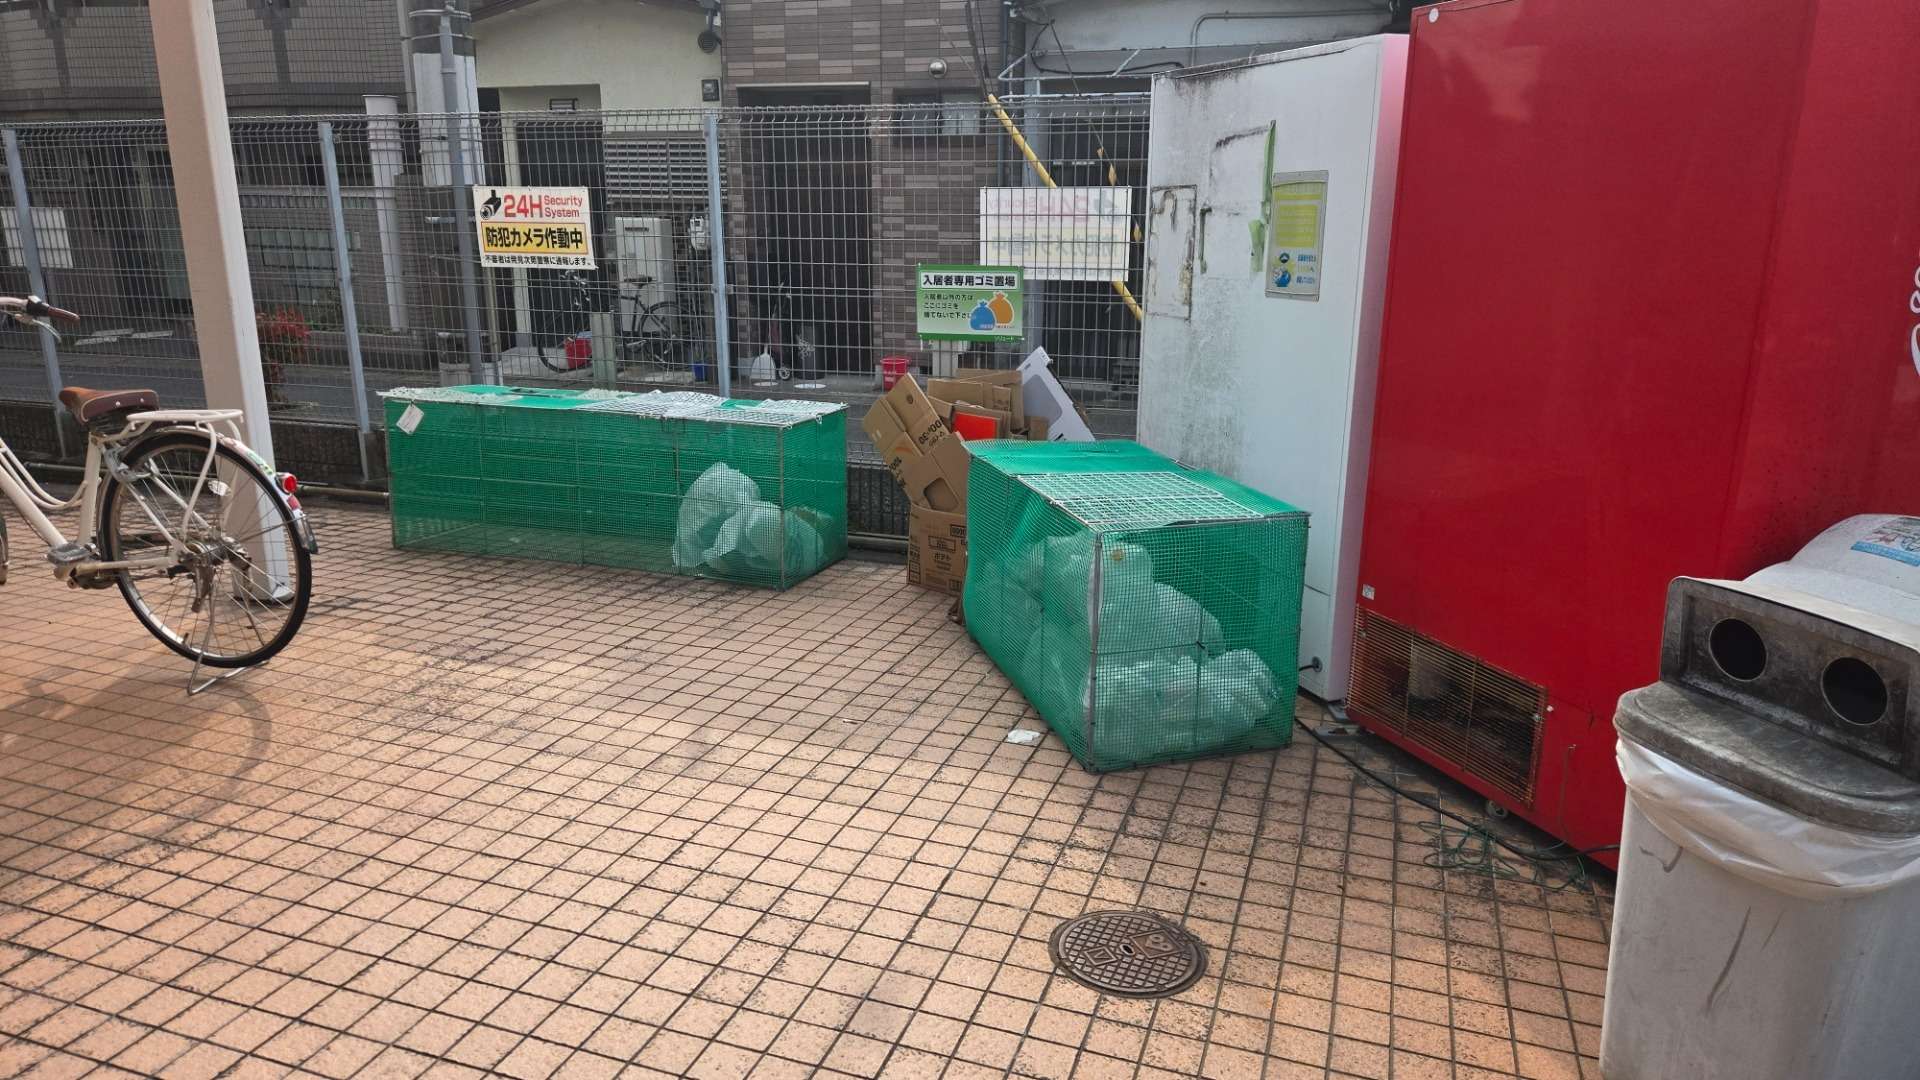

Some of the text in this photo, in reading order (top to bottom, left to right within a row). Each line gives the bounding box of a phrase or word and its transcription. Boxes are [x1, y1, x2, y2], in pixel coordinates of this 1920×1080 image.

[504, 195, 583, 218] 24H Security
[545, 207, 580, 219] System
[485, 227, 583, 249] 防犯カメラ作動中
[923, 274, 1016, 287] 入居者専用ゴミ置場
